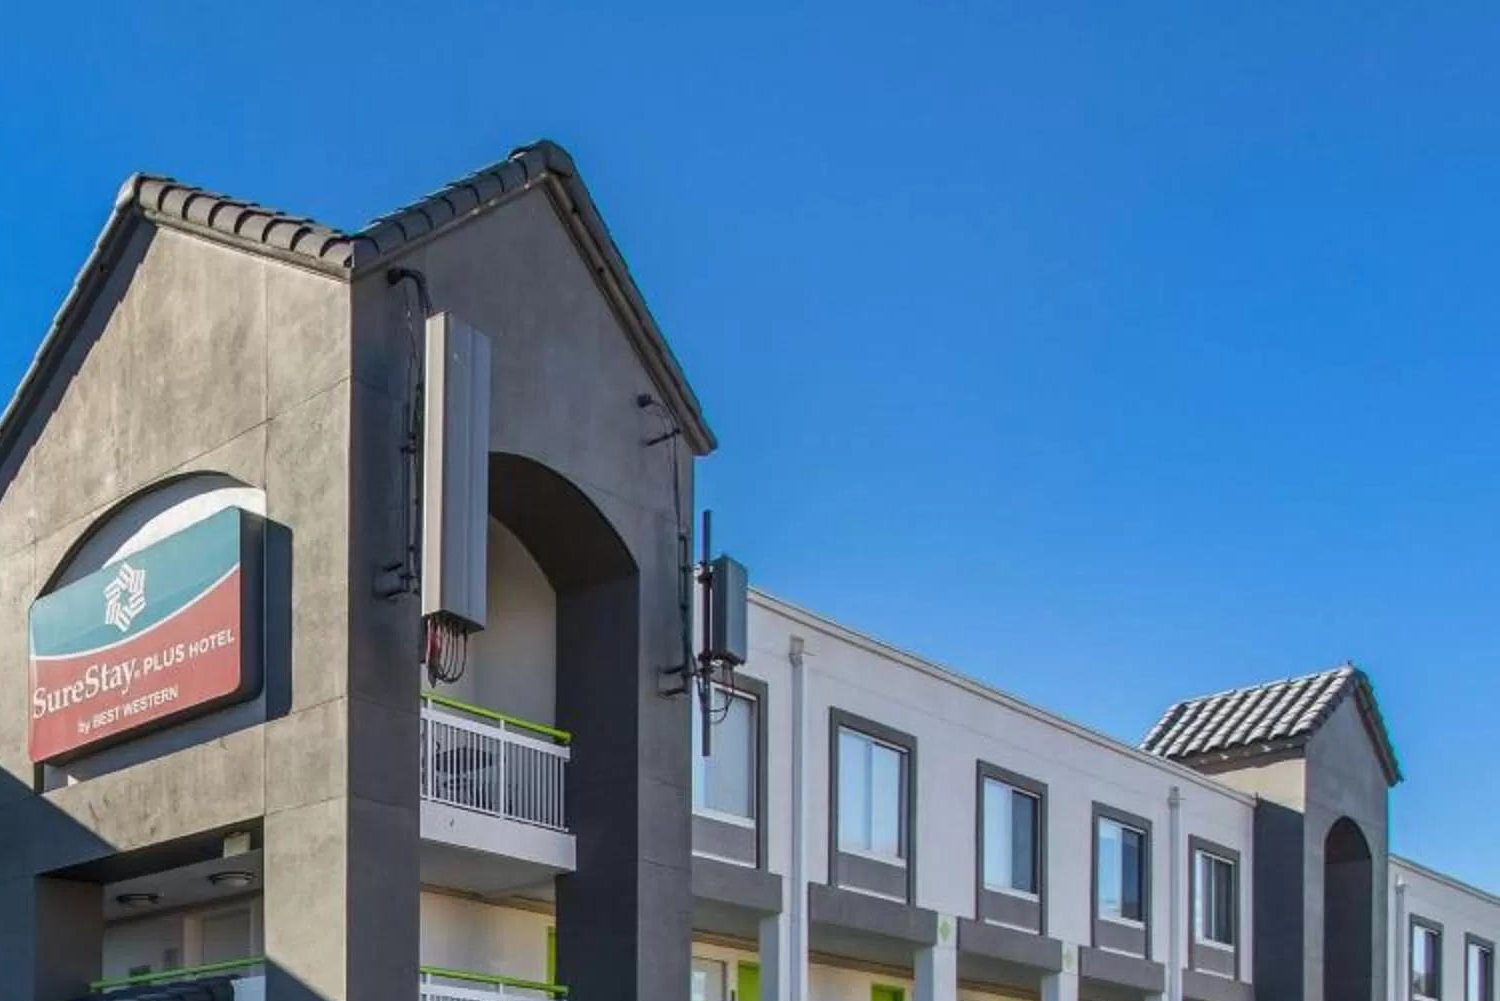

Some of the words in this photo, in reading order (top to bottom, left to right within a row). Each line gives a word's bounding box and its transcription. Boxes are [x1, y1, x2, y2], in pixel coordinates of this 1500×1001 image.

[32, 657, 137, 720] SureStay
[143, 643, 185, 675] PLUS
[189, 628, 235, 659] HOTEL
[78, 718, 91, 735] by
[92, 705, 120, 729] BEST
[122, 684, 179, 717] WESTERN
